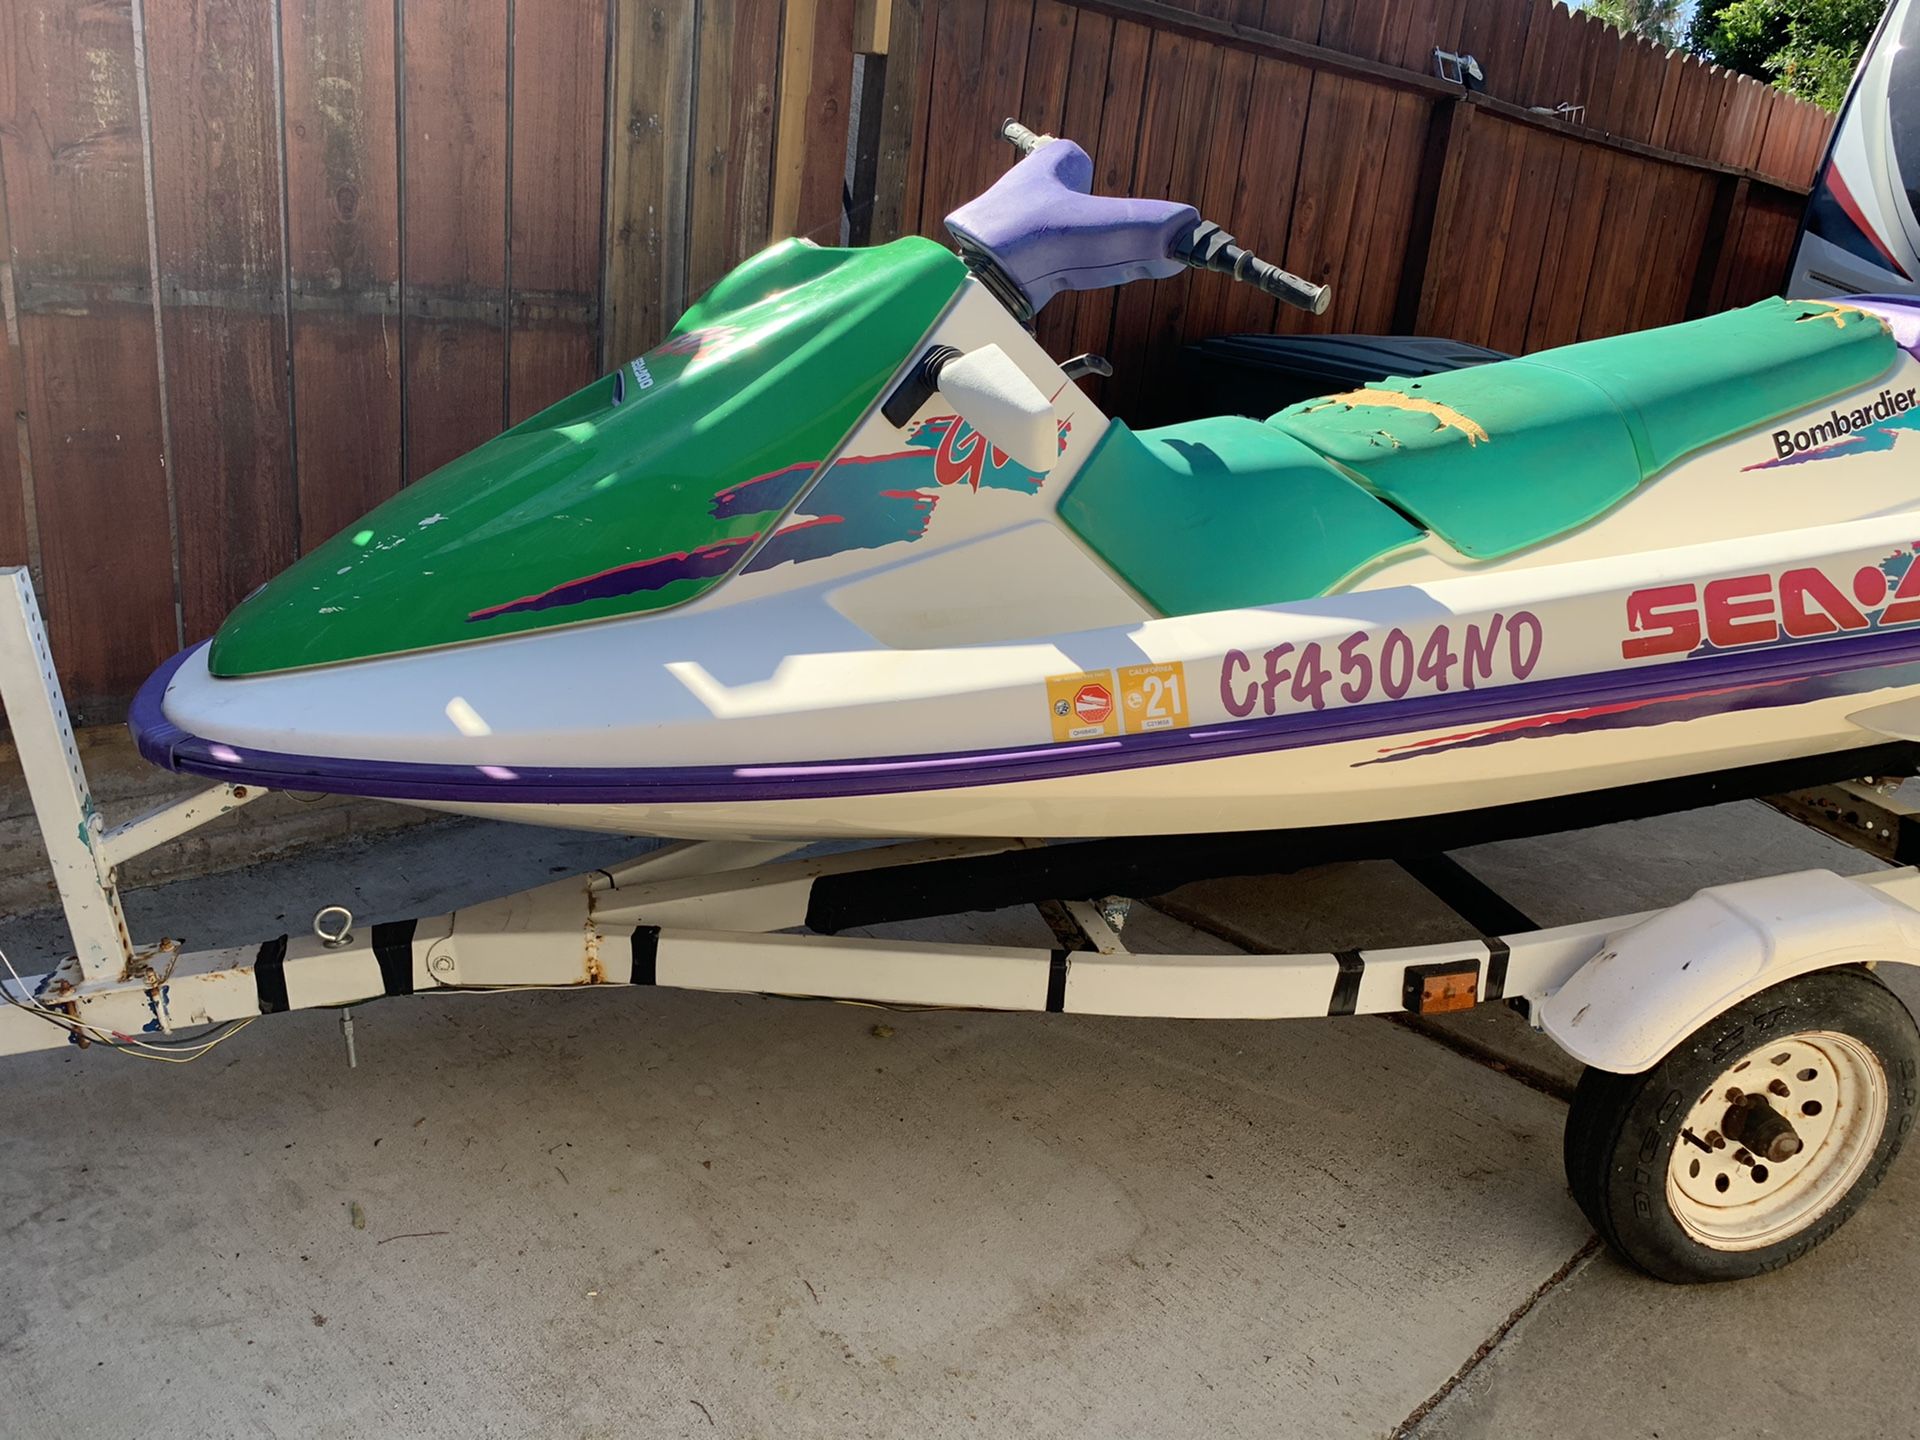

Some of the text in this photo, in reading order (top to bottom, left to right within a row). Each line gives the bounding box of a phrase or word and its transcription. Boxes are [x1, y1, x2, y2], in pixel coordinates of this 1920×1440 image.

[1772, 387, 1917, 460] Bombardier
[1143, 674, 1182, 718] 21
[1220, 611, 1543, 718] CF4504ND
